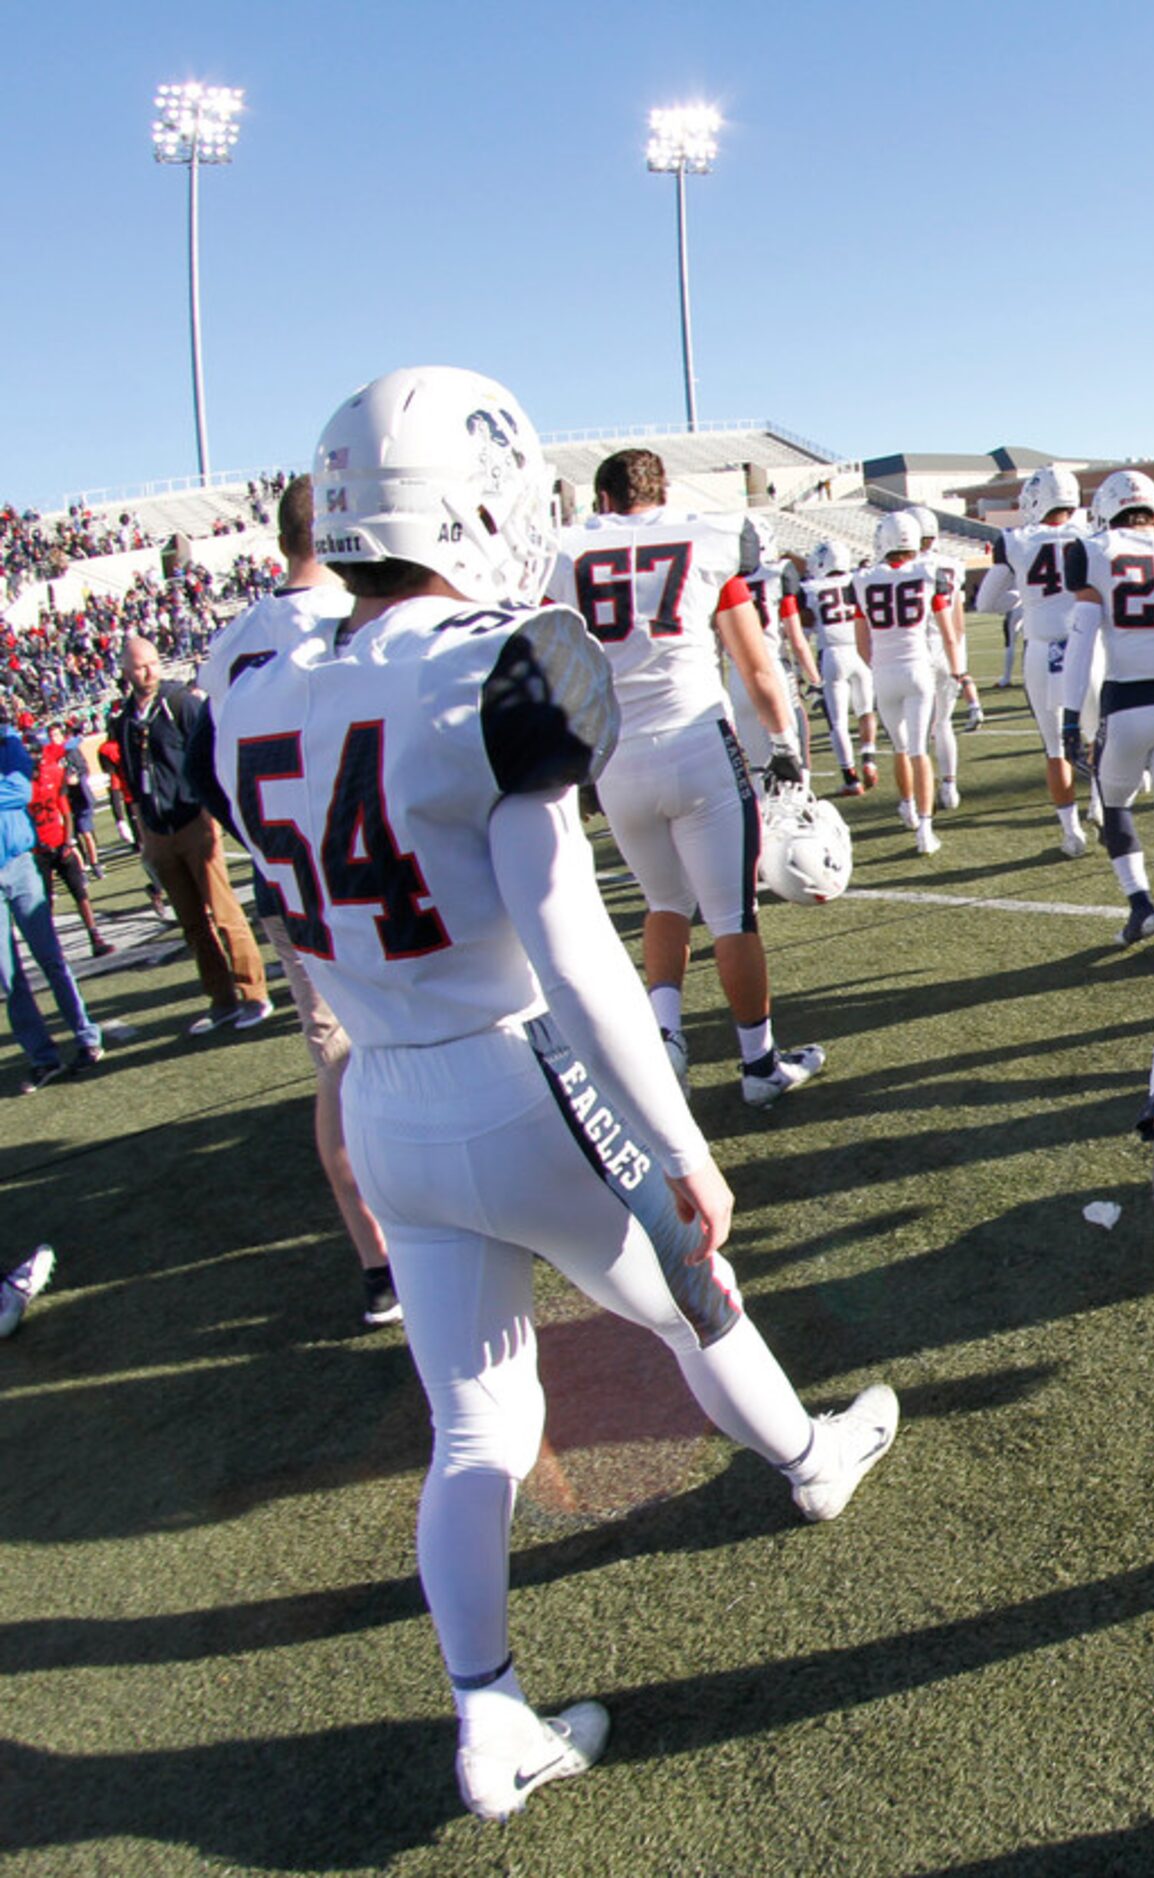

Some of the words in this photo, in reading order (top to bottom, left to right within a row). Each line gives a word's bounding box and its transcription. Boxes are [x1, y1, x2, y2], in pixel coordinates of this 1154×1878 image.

[326, 486, 348, 513] 54
[438, 522, 463, 542] AG
[574, 540, 693, 644] 67
[865, 577, 925, 630] 86
[236, 717, 454, 962] 54
[558, 1060, 651, 1191] EAGLES
